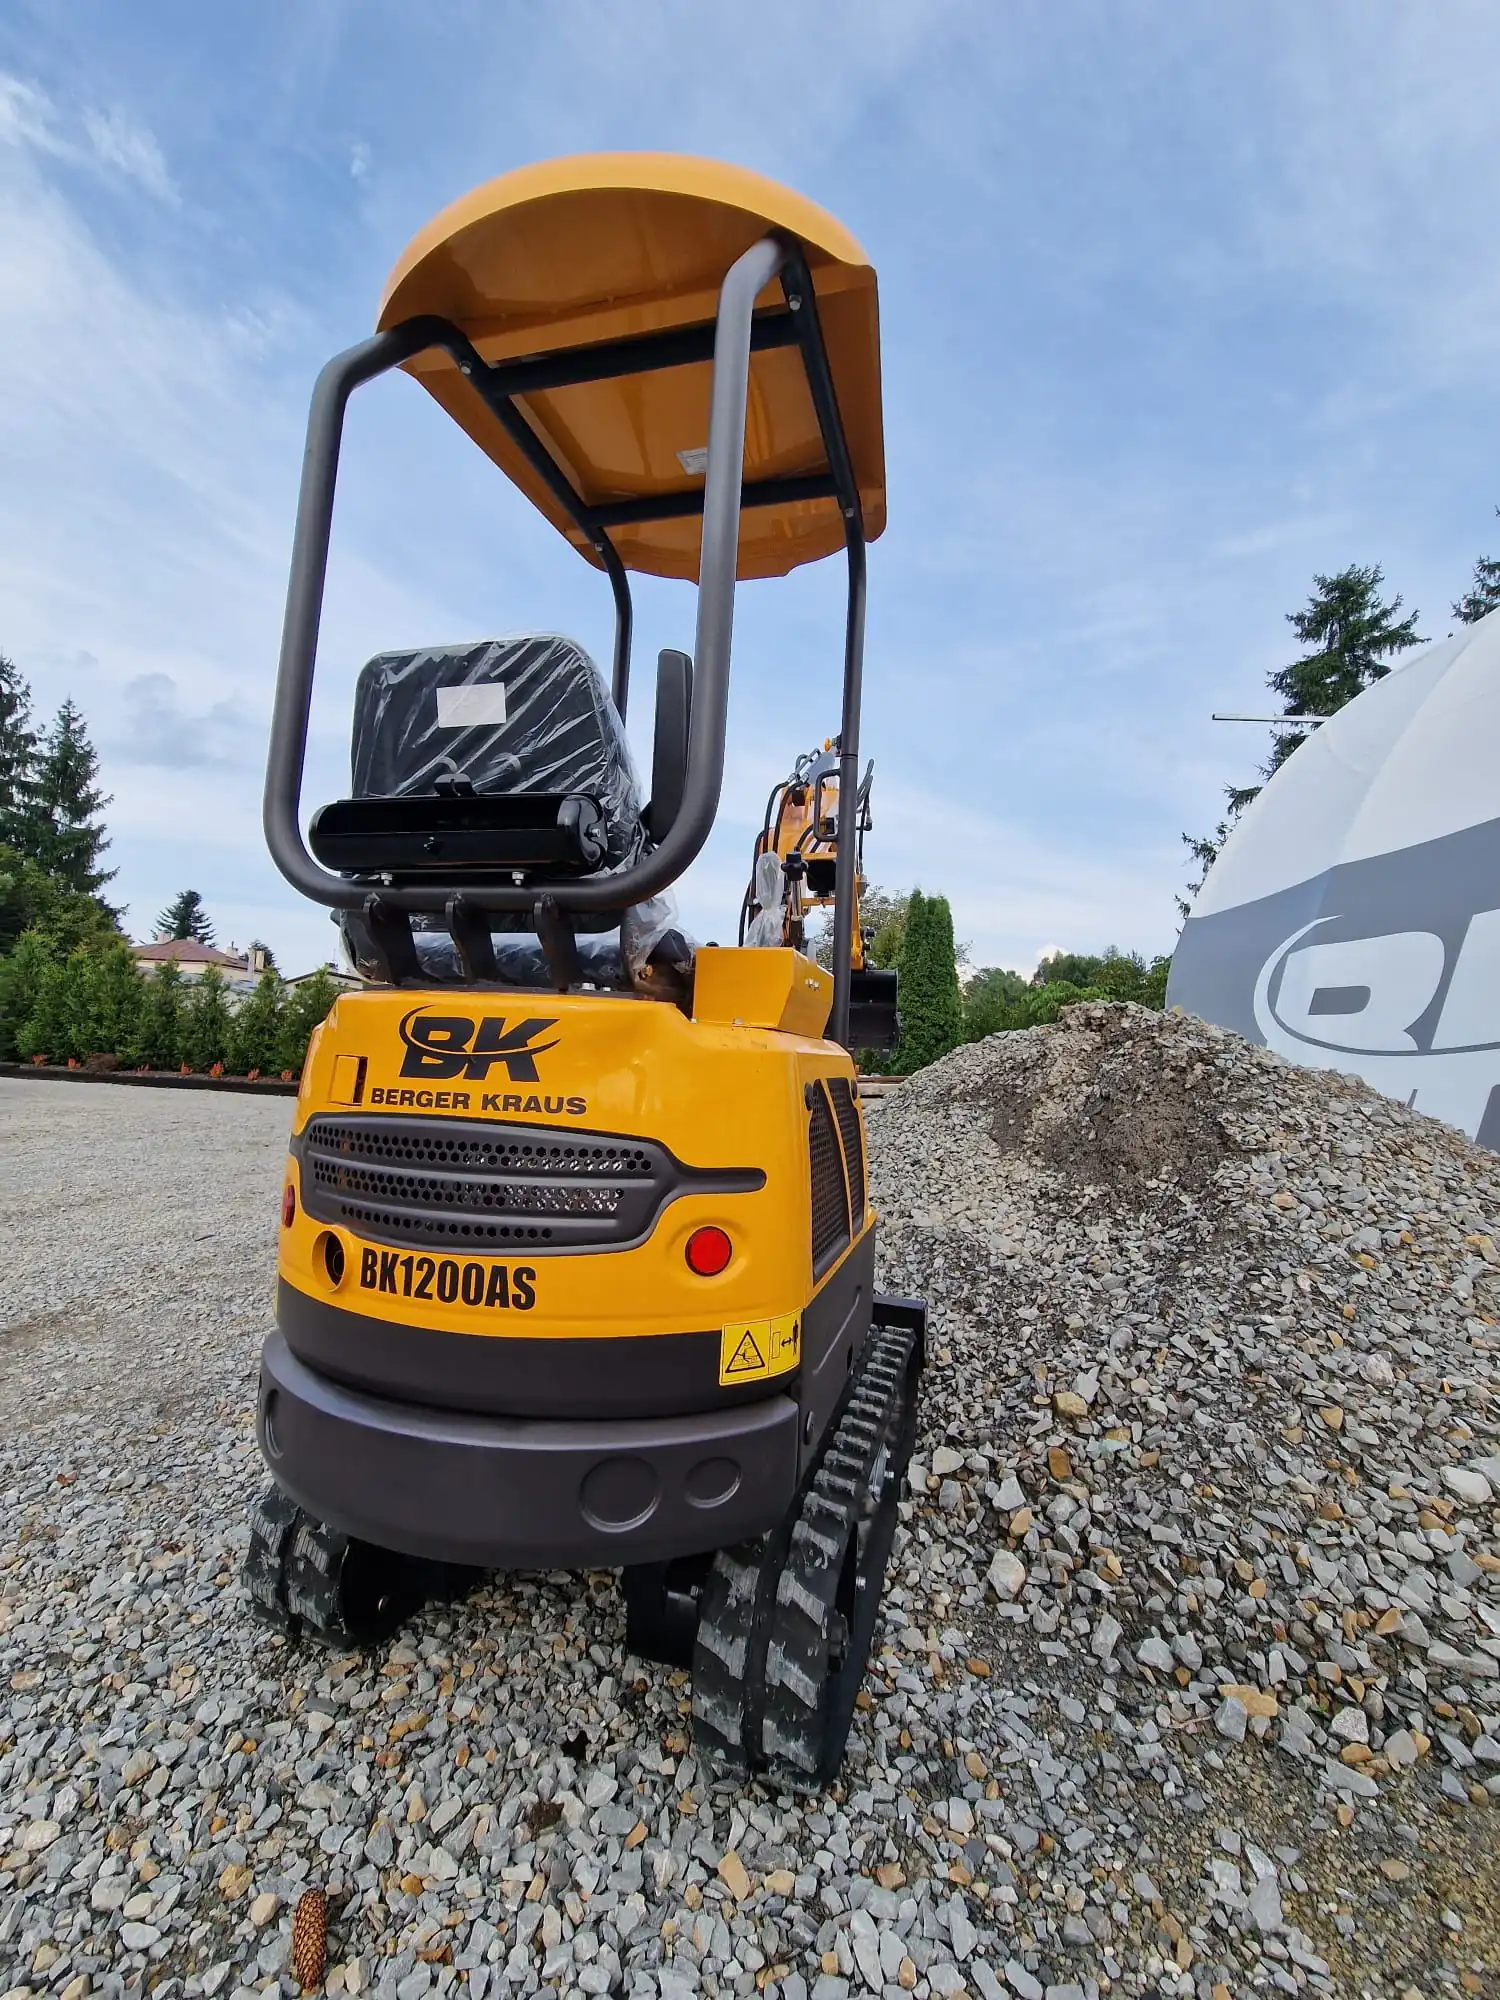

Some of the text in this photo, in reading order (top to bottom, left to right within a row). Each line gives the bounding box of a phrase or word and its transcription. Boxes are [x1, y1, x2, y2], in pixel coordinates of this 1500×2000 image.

[399, 1005, 561, 1082] BK
[370, 1087, 587, 1115] BERGER KRAUS
[360, 1247, 536, 1310] BK1200AS
